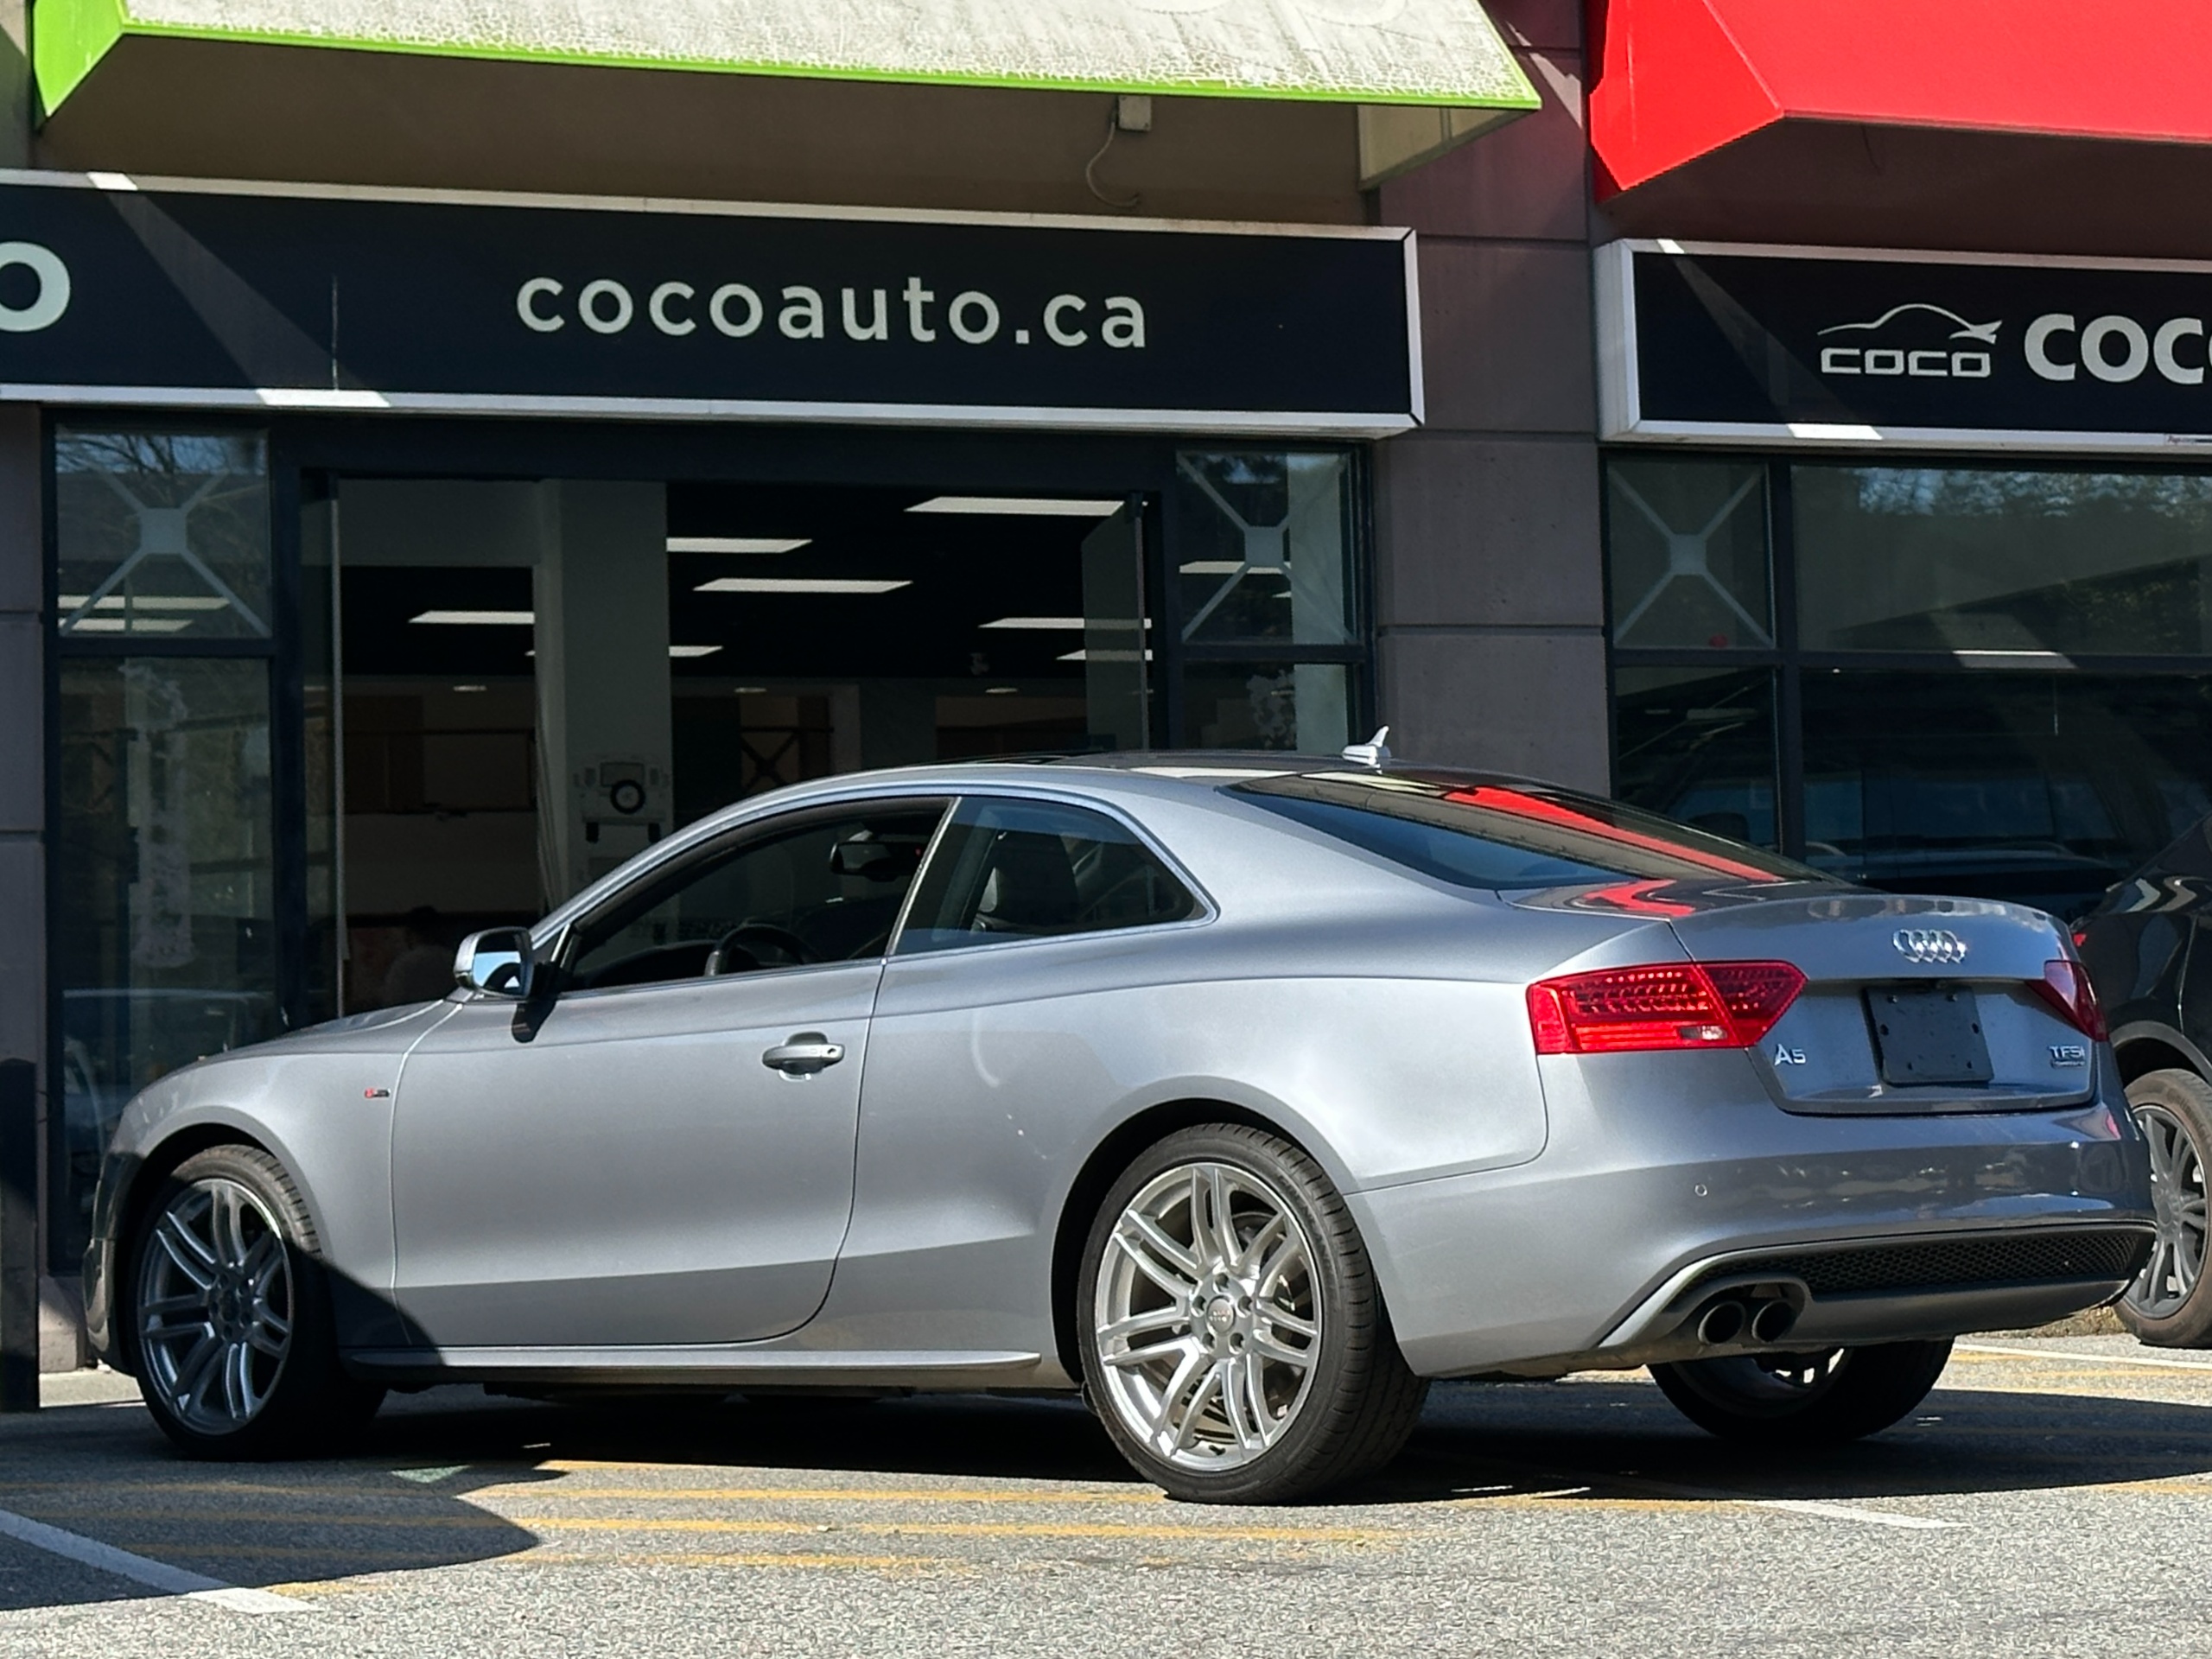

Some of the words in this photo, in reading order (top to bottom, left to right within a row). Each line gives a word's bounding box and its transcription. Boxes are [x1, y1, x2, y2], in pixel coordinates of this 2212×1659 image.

[517, 276, 1146, 348] cocoauto.ca
[1821, 347, 1992, 378] COCO
[2024, 313, 2212, 385] COC
[1774, 1043, 1807, 1066] A5
